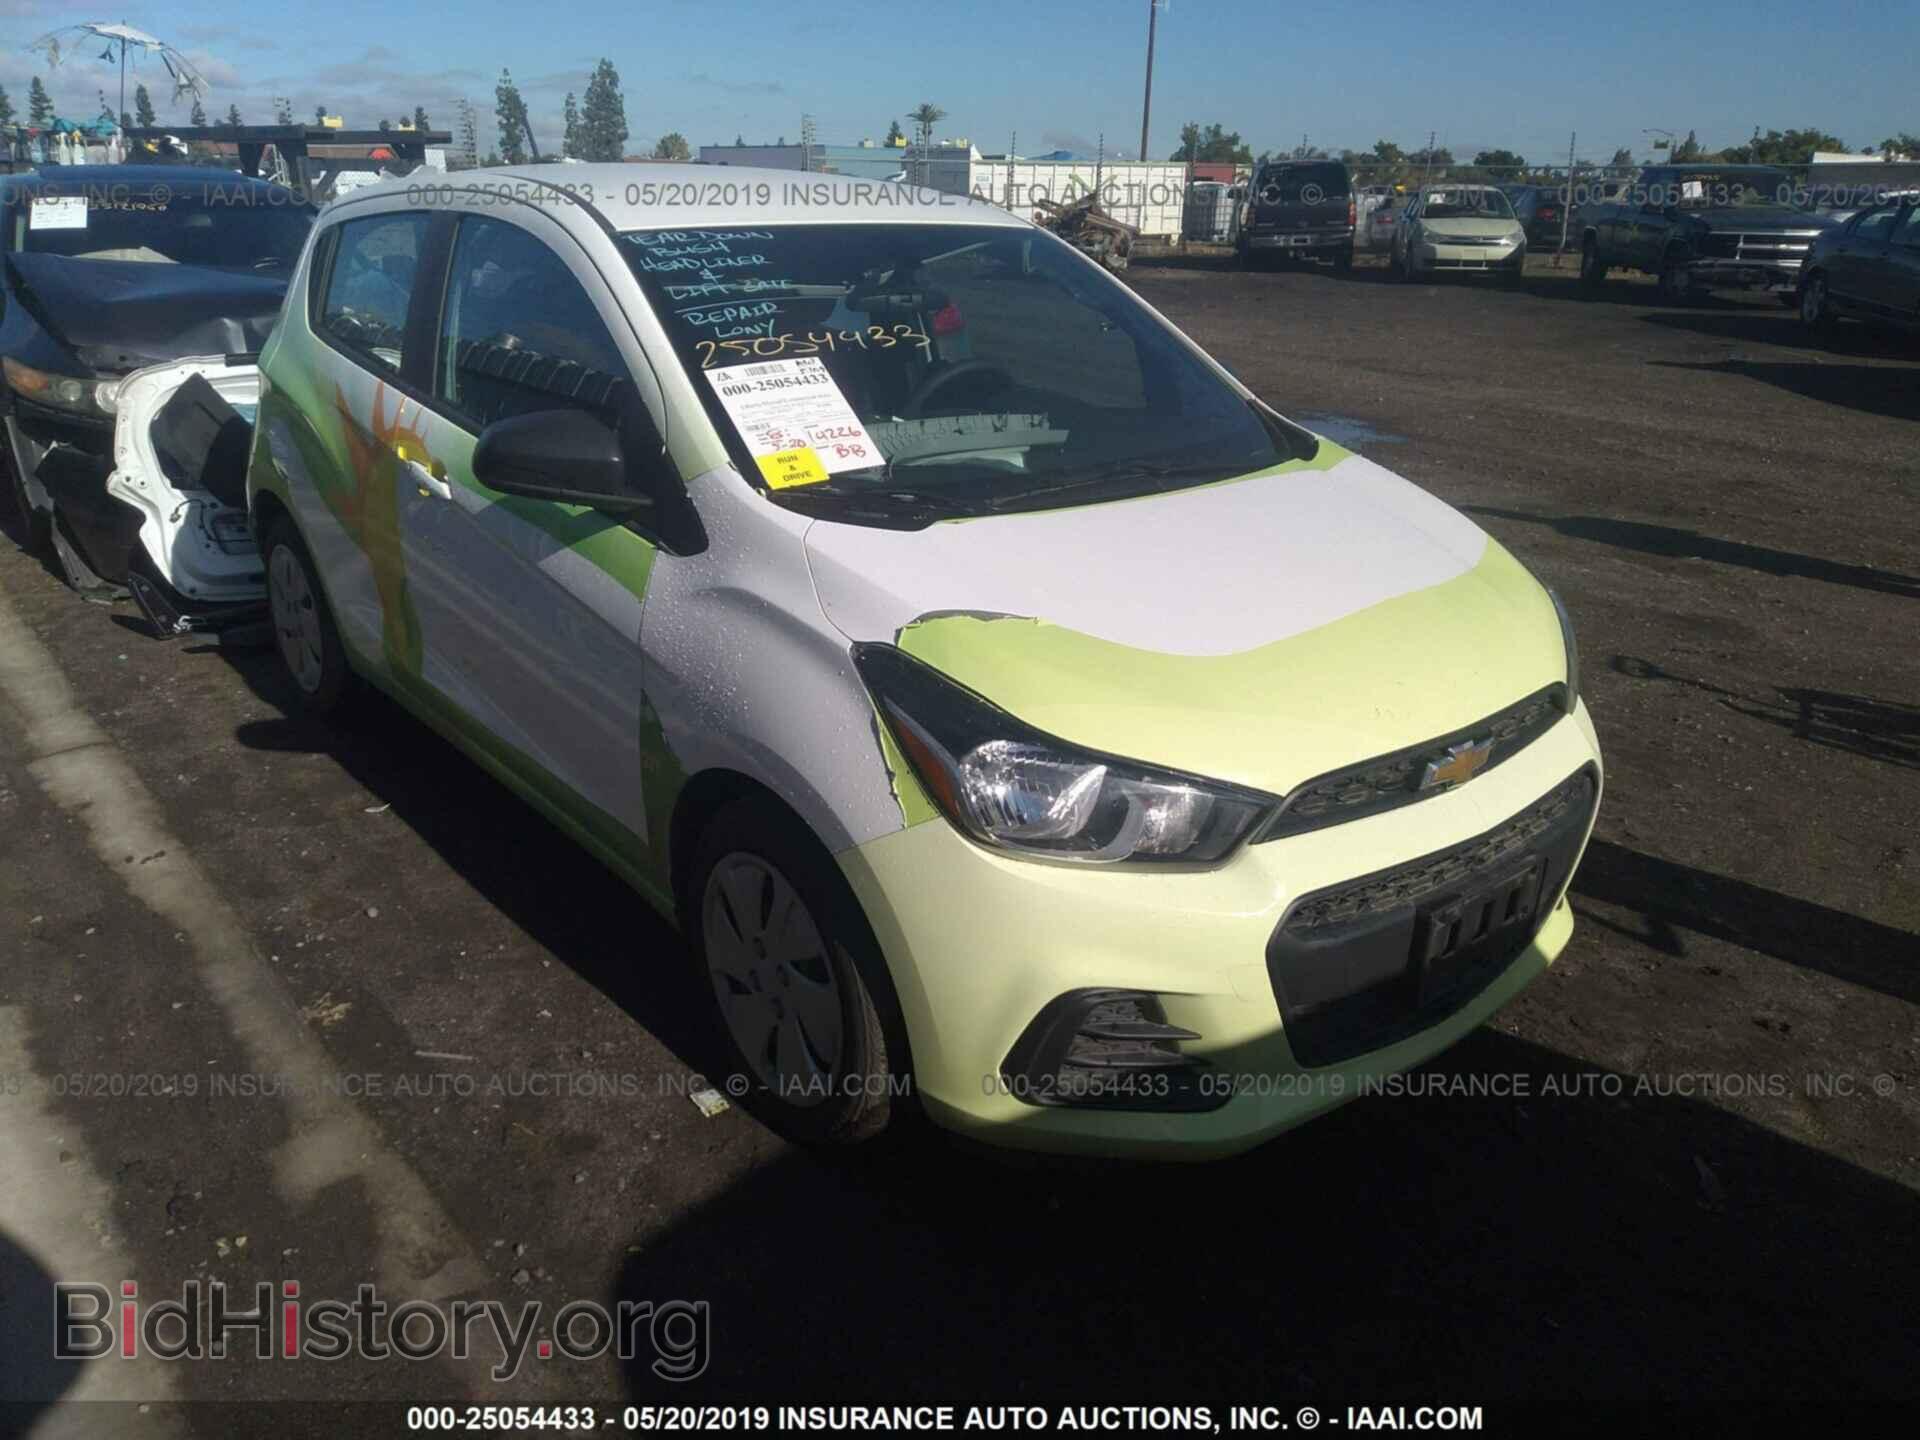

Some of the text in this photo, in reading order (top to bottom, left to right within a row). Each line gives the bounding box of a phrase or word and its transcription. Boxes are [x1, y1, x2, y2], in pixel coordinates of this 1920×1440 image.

[683, 302, 784, 325] REPAIR
[722, 373, 829, 396] 000-25054433
[776, 455, 799, 464] RUN
[788, 463, 797, 471] &
[782, 470, 813, 482] DRIVE
